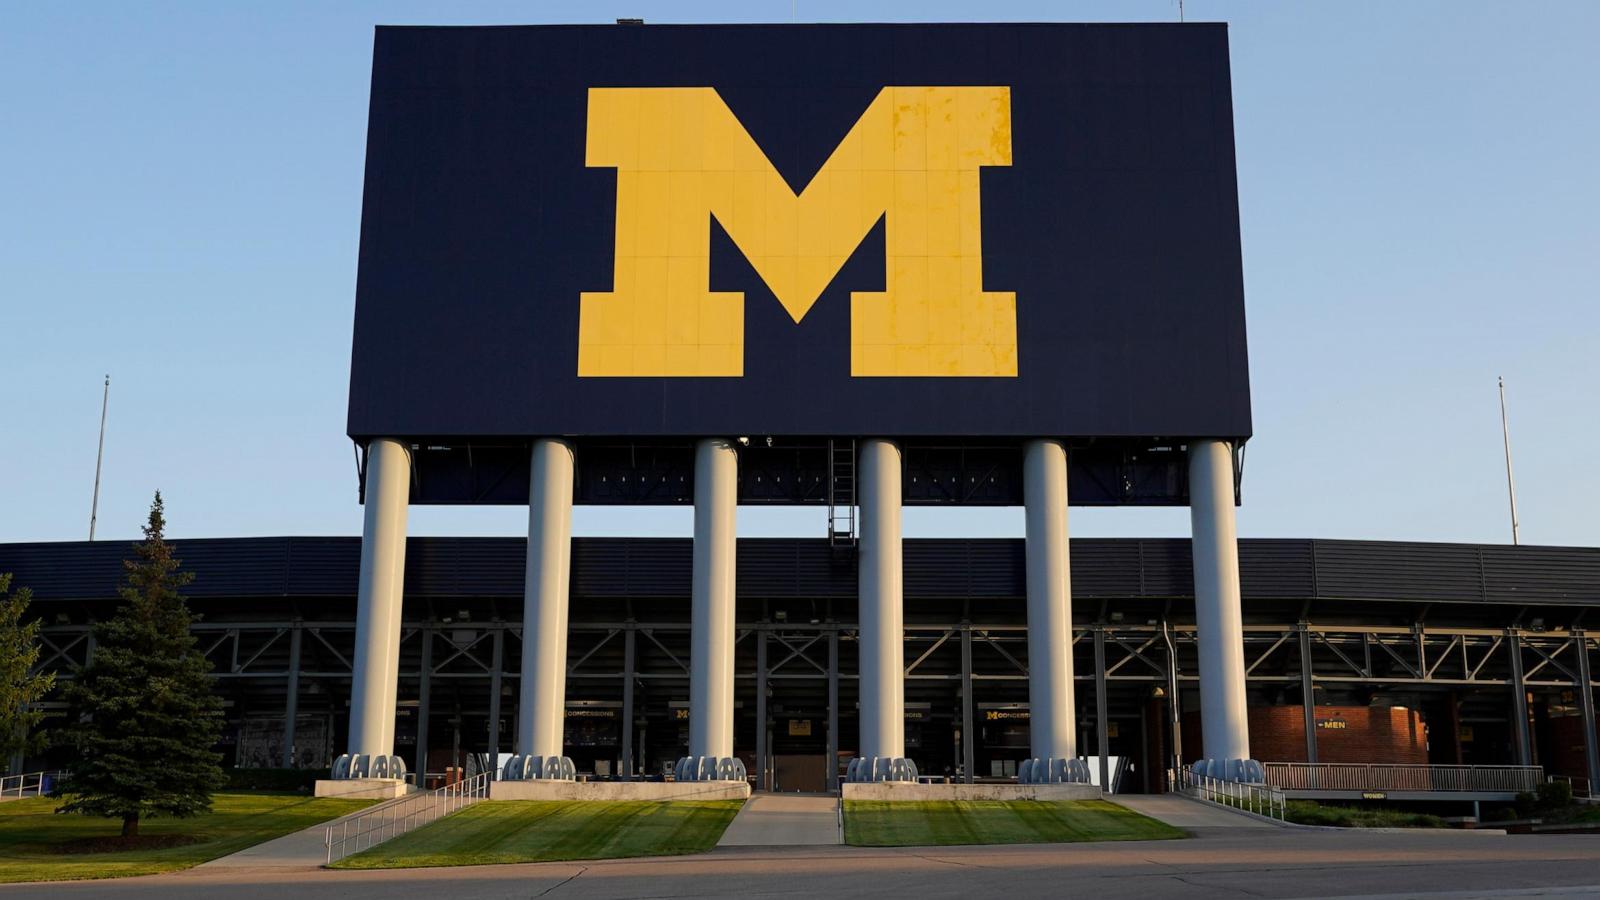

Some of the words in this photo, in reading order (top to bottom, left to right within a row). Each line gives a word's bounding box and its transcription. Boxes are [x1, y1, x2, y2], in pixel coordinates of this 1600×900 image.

[577, 86, 1018, 377] M
[1324, 721, 1346, 729] MEN
[1362, 792, 1385, 800] WOMEN
